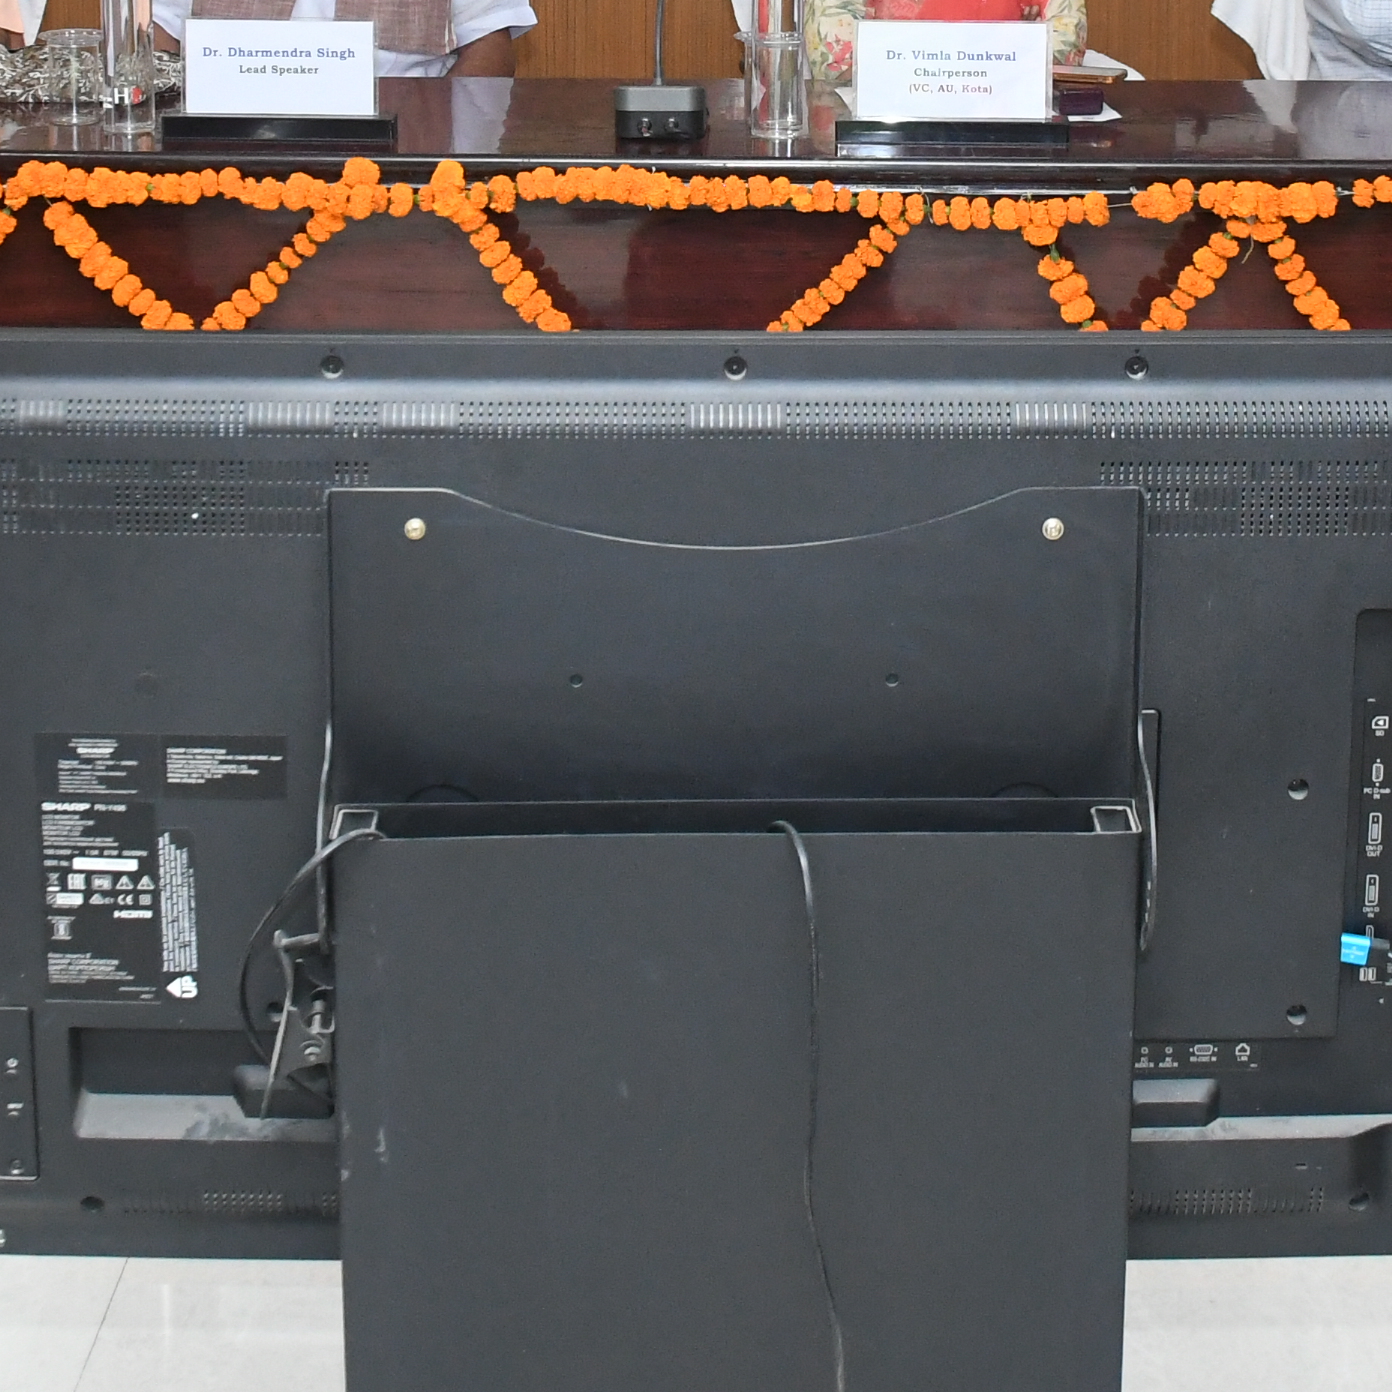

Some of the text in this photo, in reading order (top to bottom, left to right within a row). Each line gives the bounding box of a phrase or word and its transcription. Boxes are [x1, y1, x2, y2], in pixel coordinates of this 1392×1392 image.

[202, 46, 356, 61] Dr. Dharmendra Singh
[886, 50, 1017, 61] Dr. Vimla Dunkwal
[239, 64, 319, 76] Lead Speaker
[913, 68, 988, 79] Chairperson
[909, 83, 993, 95] (VC, AU, Kota)
[41, 802, 91, 812] SHARP
[181, 975, 198, 999] UP
